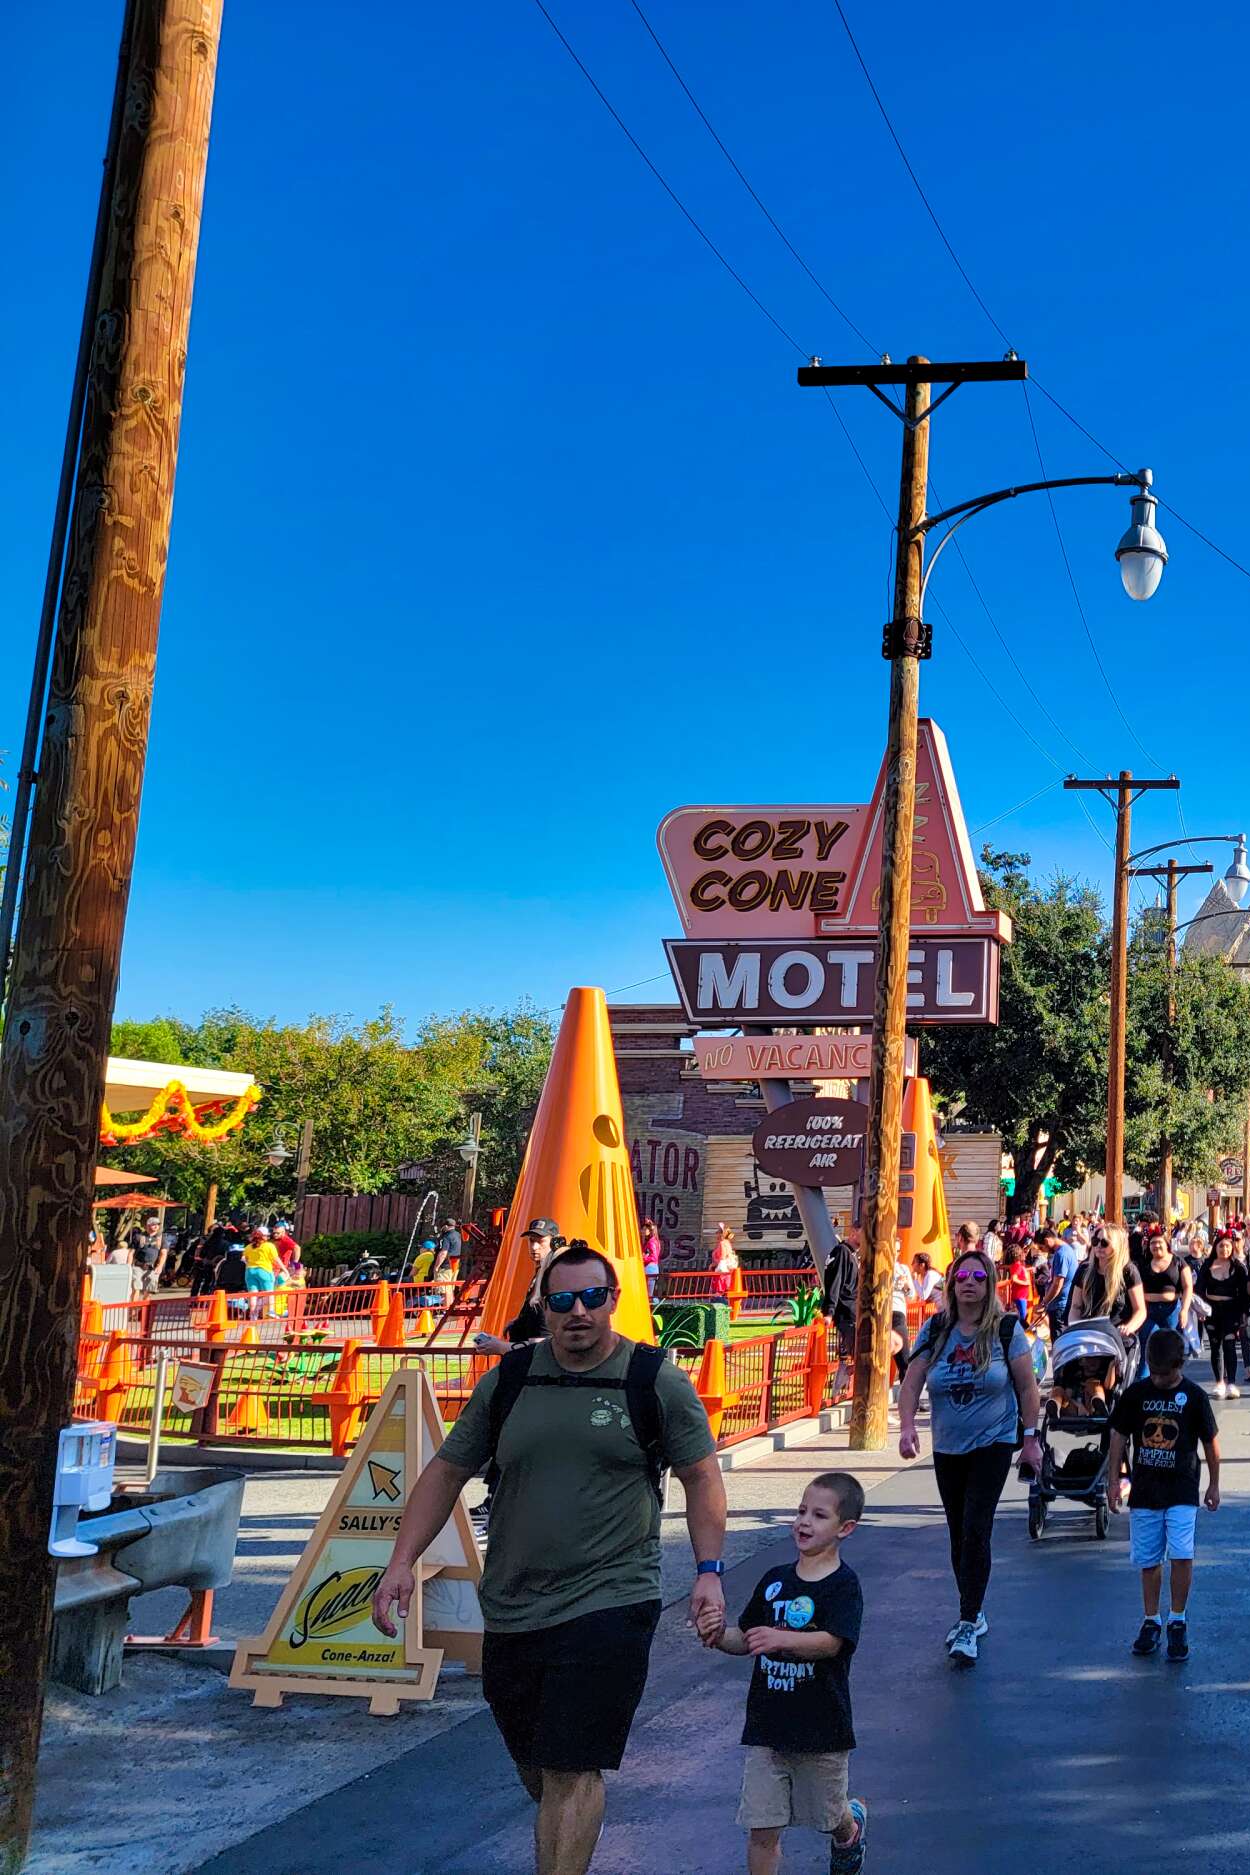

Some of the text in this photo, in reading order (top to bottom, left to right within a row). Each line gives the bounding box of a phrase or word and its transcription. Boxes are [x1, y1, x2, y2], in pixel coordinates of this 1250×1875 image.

[693, 819, 849, 861] COZY
[690, 870, 846, 912] CONE
[697, 950, 974, 1008] MOTEL
[704, 1043, 871, 1071] NO VACANC
[806, 1115, 844, 1131] 100%
[764, 1133, 862, 1150] REFRIGERAT
[631, 1138, 700, 1192] ATOR
[809, 1152, 838, 1168] AIR
[1142, 1400, 1184, 1413] COOLEST
[1139, 1447, 1176, 1461] PUMPKIN
[339, 1515, 401, 1531] SALLY'S
[321, 1648, 396, 1663] Cone-Anza!
[767, 1675, 795, 1692] BOY!
